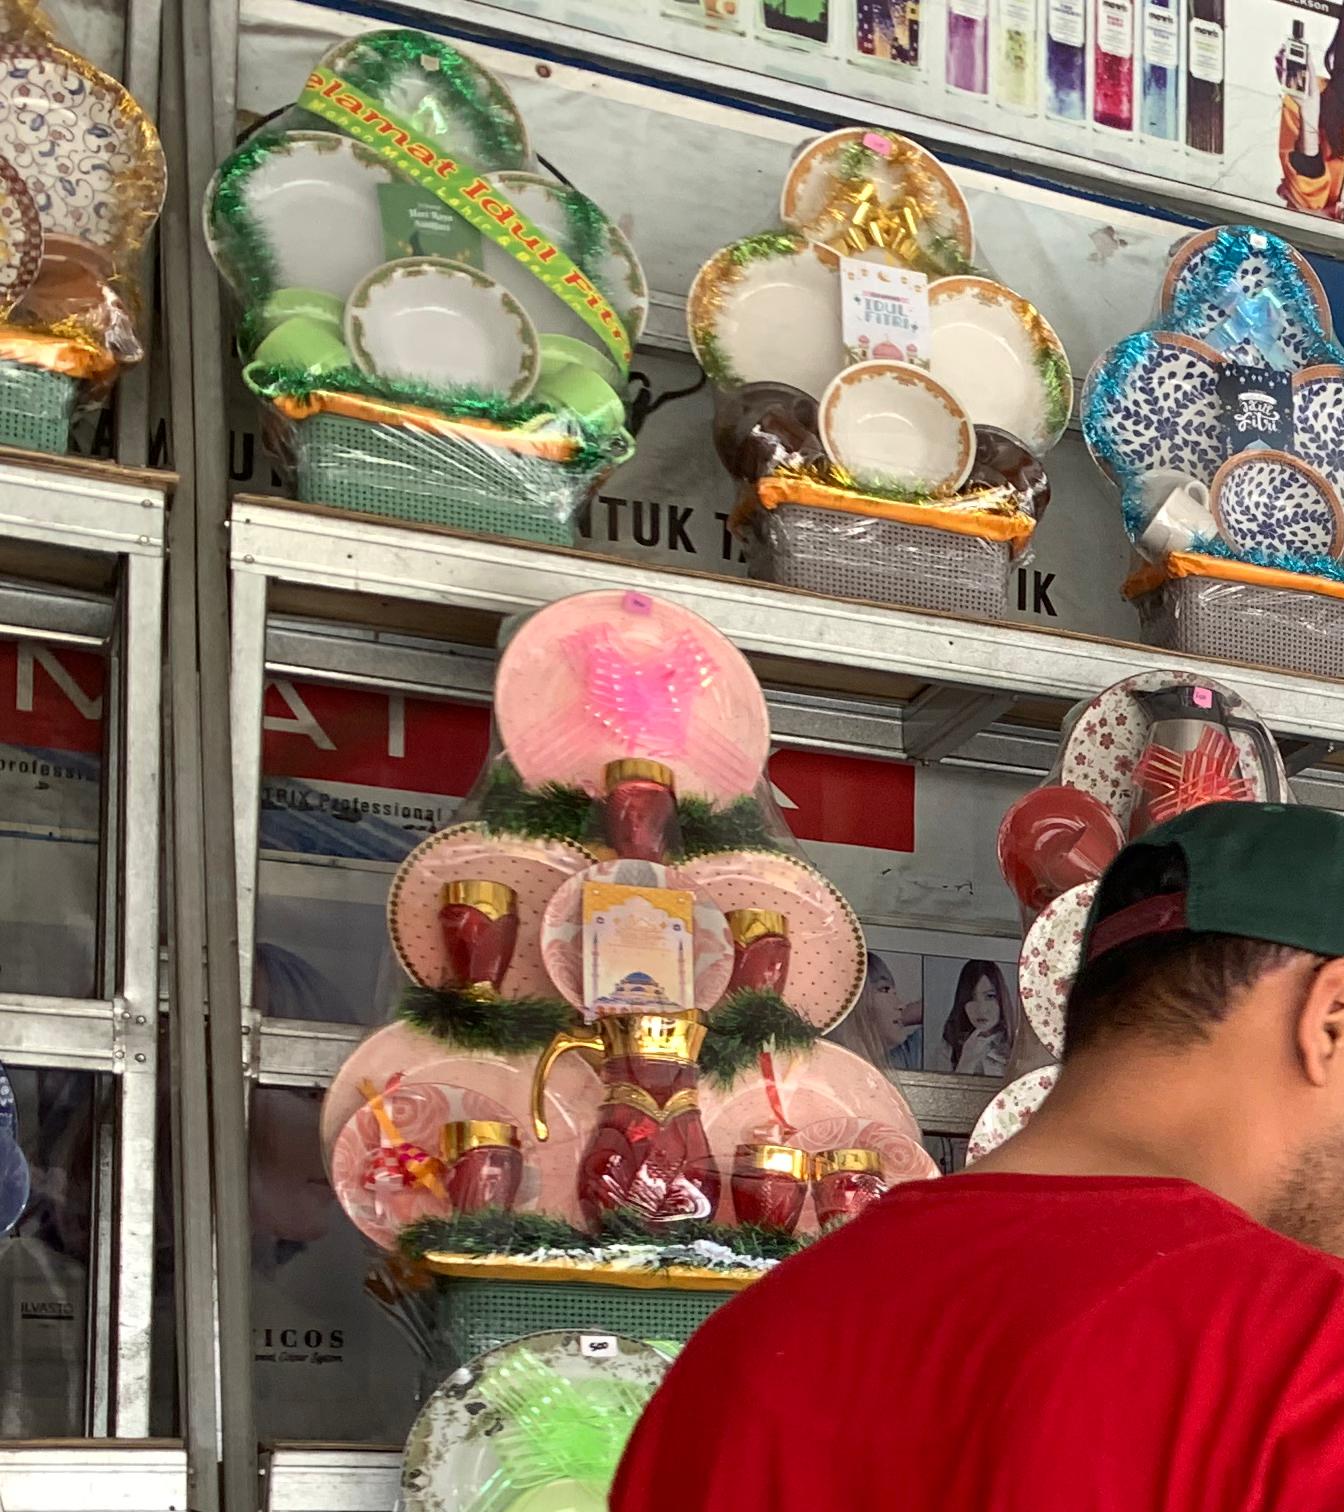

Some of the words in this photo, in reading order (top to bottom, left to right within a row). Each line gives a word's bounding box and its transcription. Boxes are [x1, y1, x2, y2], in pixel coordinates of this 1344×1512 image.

[461, 178, 558, 264] Idul
[865, 298, 909, 317] IDUL
[865, 311, 909, 329] FITRI
[579, 496, 697, 554] TUK
[319, 793, 442, 822] Professional
